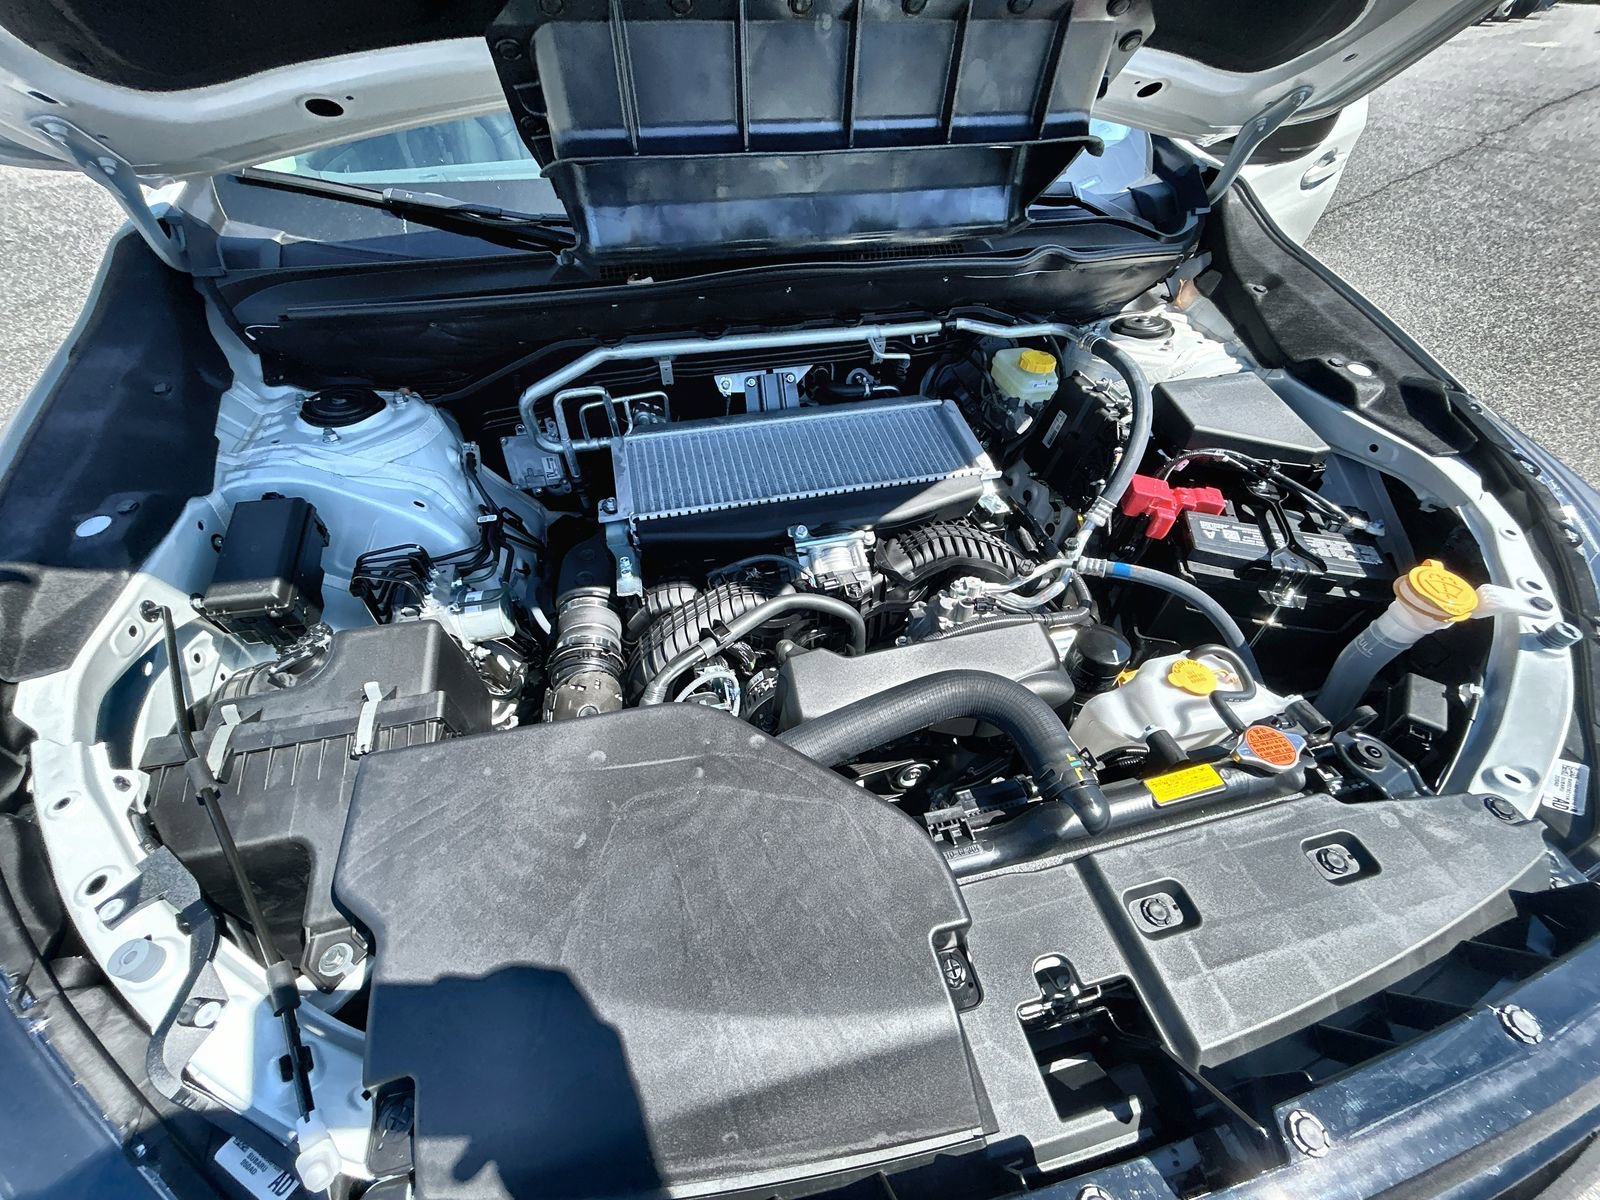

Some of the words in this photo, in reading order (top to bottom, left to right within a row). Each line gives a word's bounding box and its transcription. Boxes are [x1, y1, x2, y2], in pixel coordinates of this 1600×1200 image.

[1552, 796, 1570, 811] AD
[246, 1152, 268, 1173] SUBARU
[267, 1171, 296, 1197] AD
